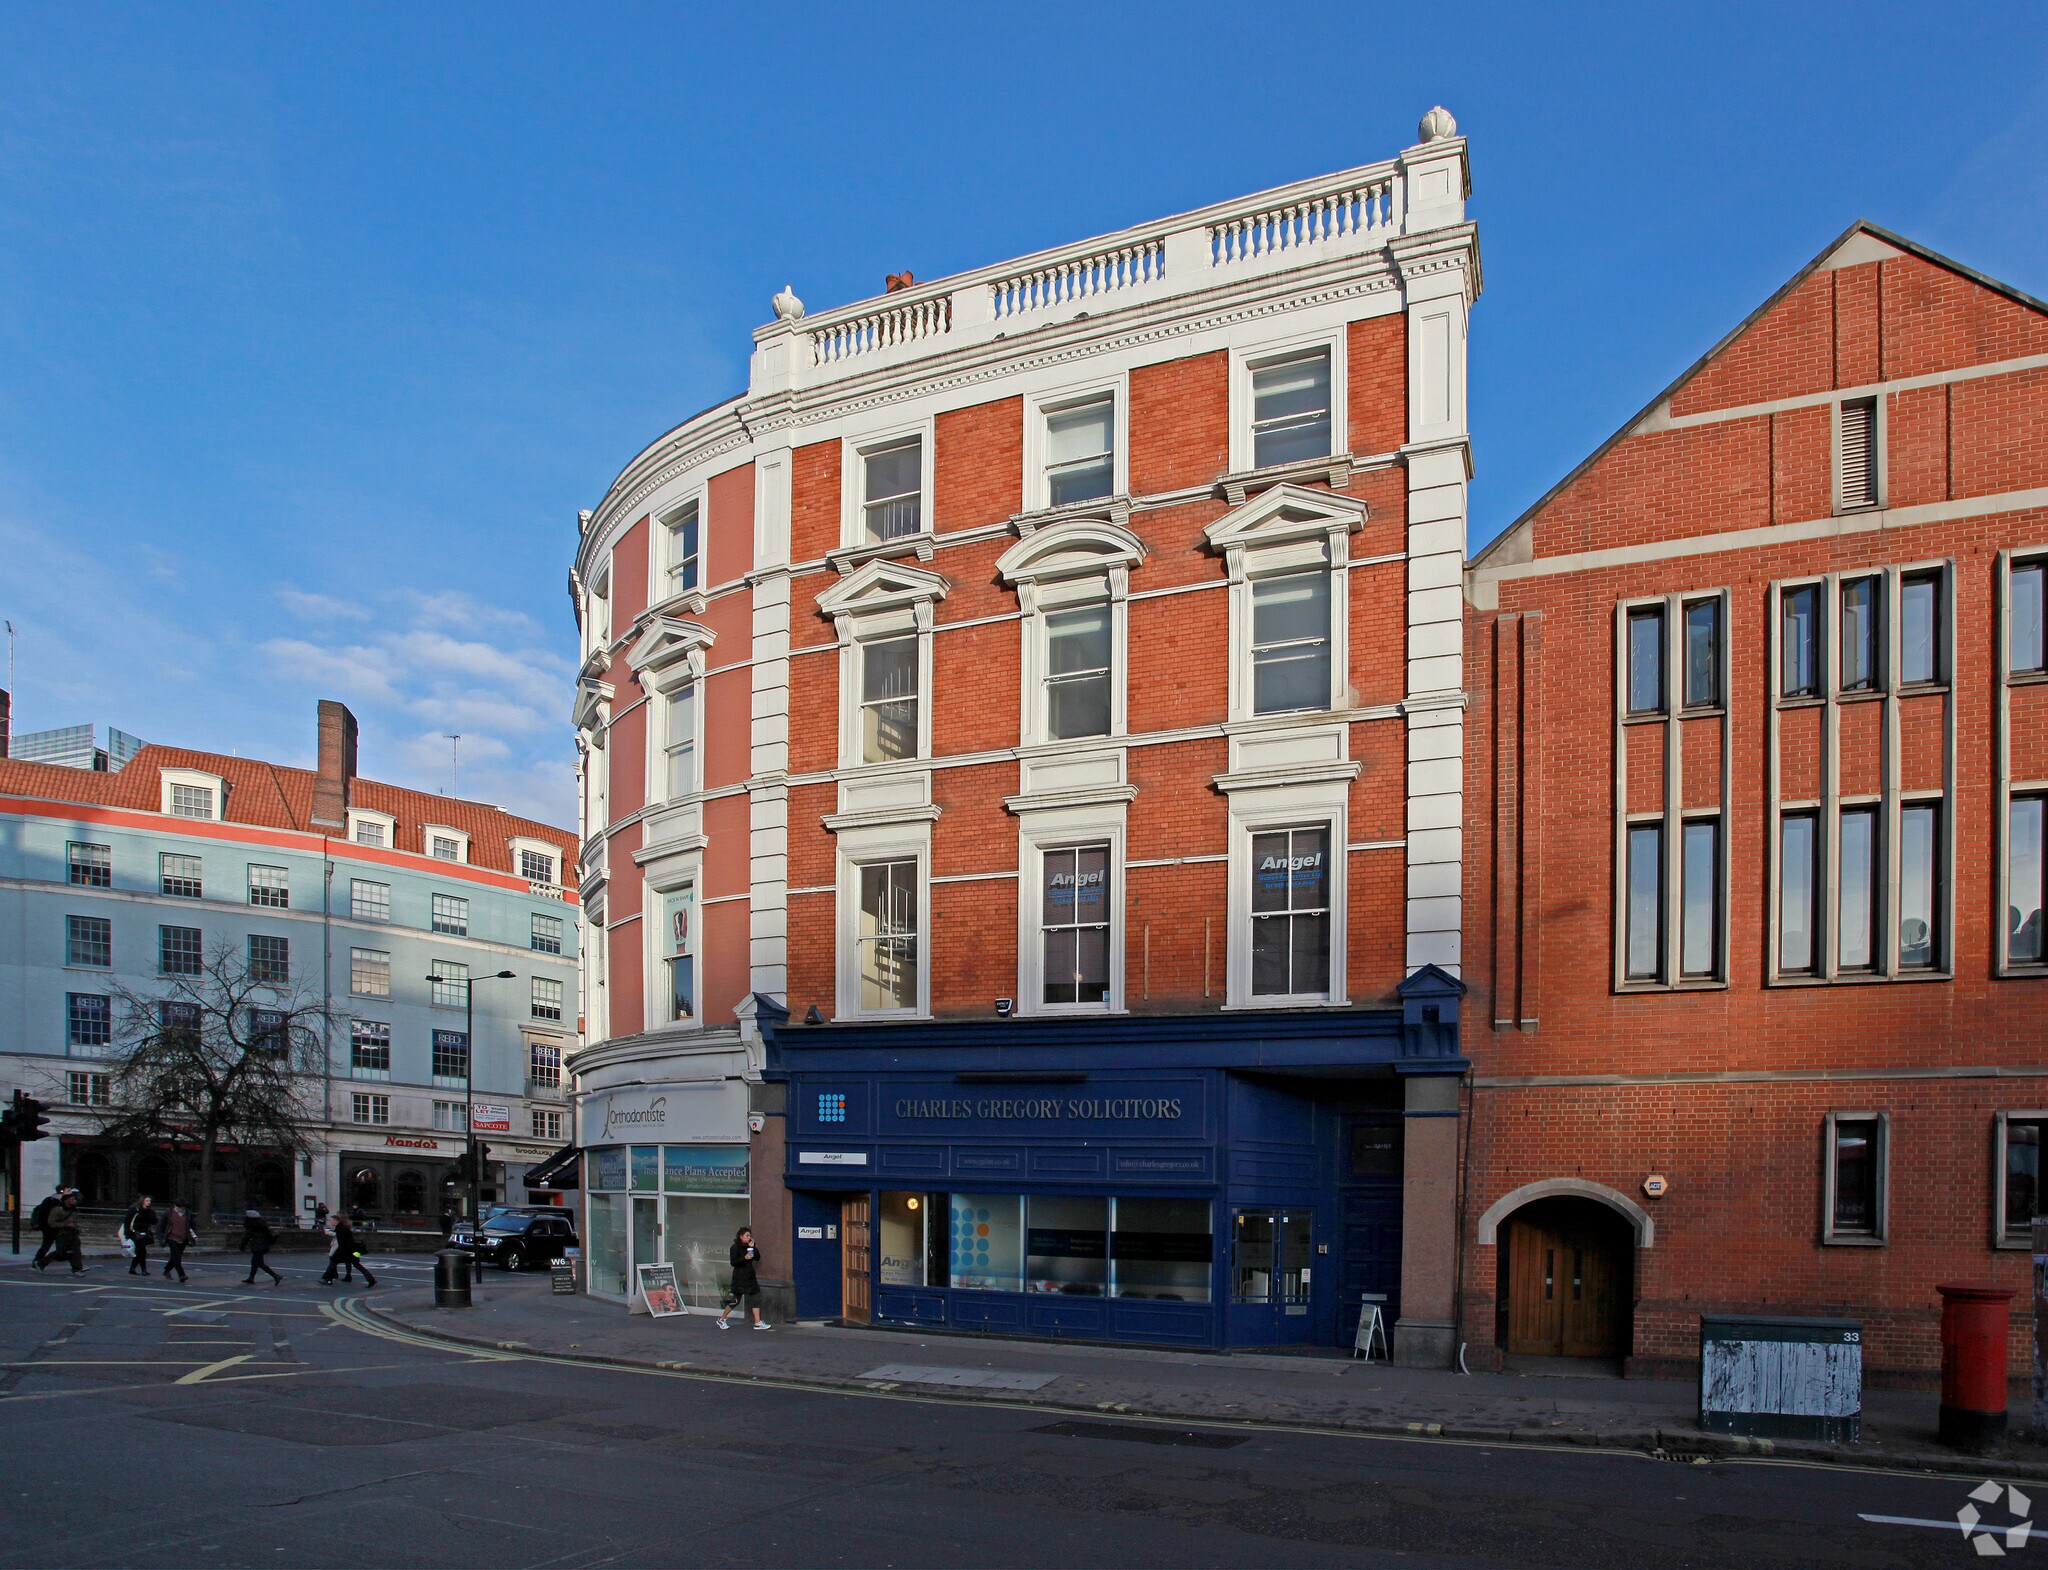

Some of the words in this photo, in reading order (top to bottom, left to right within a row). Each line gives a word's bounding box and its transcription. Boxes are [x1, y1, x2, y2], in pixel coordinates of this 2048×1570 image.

[1260, 852, 1322, 871] Angel
[1050, 869, 1105, 886] Angel
[77, 997, 105, 1007] REED
[438, 1033, 461, 1043] REED
[896, 1099, 972, 1119] CHARLES
[977, 1099, 1064, 1119] GREGORY
[1069, 1099, 1181, 1119] SOLICITORS
[610, 1108, 666, 1124] Orthodontiste
[475, 1121, 508, 1131] SAPCOTE
[384, 1135, 438, 1149] Nando's
[515, 1147, 553, 1156] broadway
[823, 1153, 843, 1161] Angel
[643, 1165, 683, 1177] Insuance
[684, 1165, 707, 1177] Plans
[708, 1166, 747, 1180] Accepted
[1843, 1332, 1859, 1341] 33
